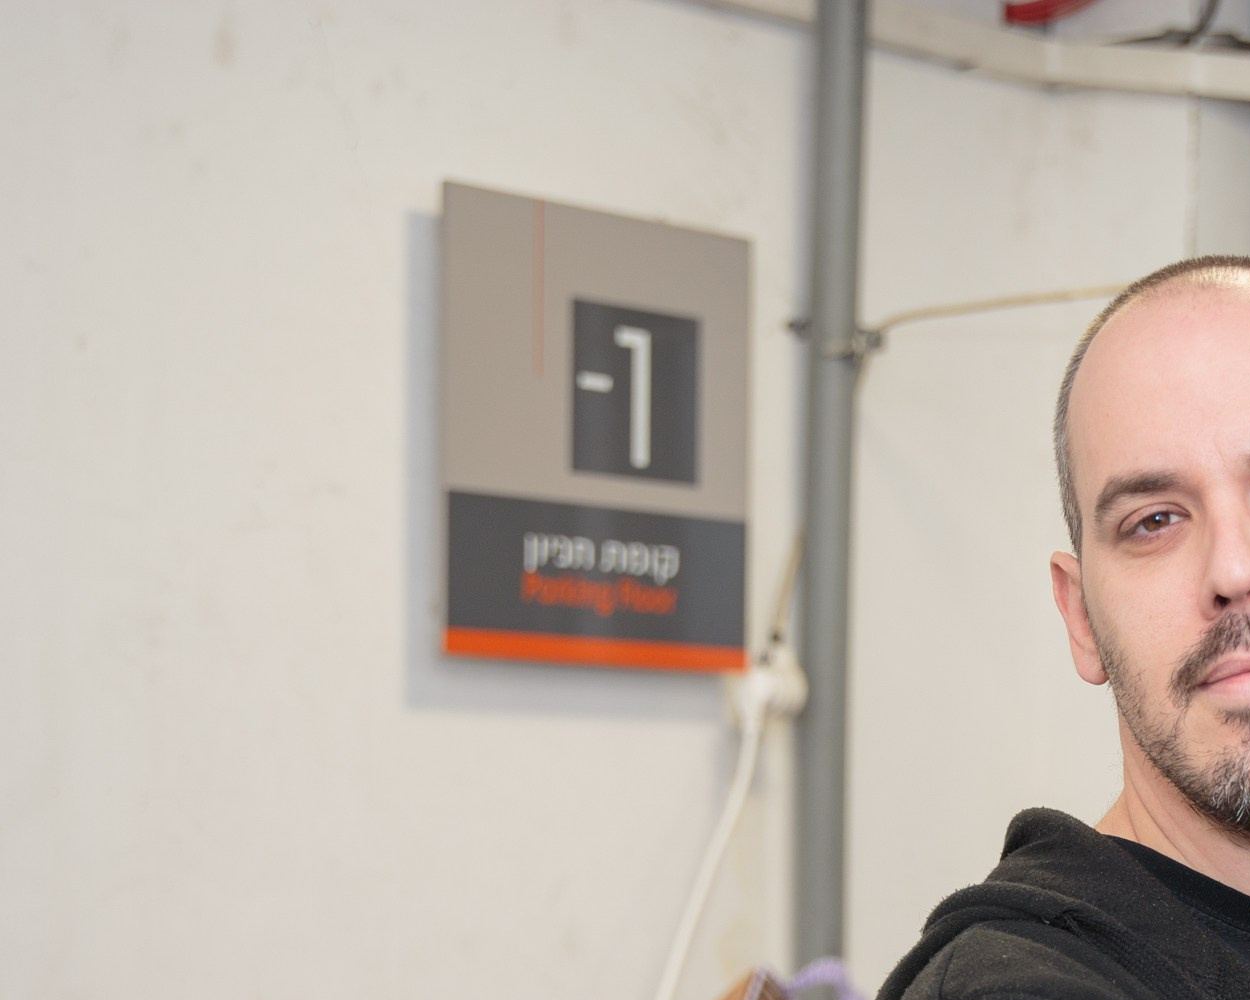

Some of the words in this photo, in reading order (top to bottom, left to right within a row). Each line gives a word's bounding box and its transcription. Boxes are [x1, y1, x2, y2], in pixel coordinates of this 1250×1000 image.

[575, 323, 653, 470] -1
[523, 531, 596, 574] חניון
[600, 539, 681, 586] קומת
[522, 571, 616, 618] Parking
